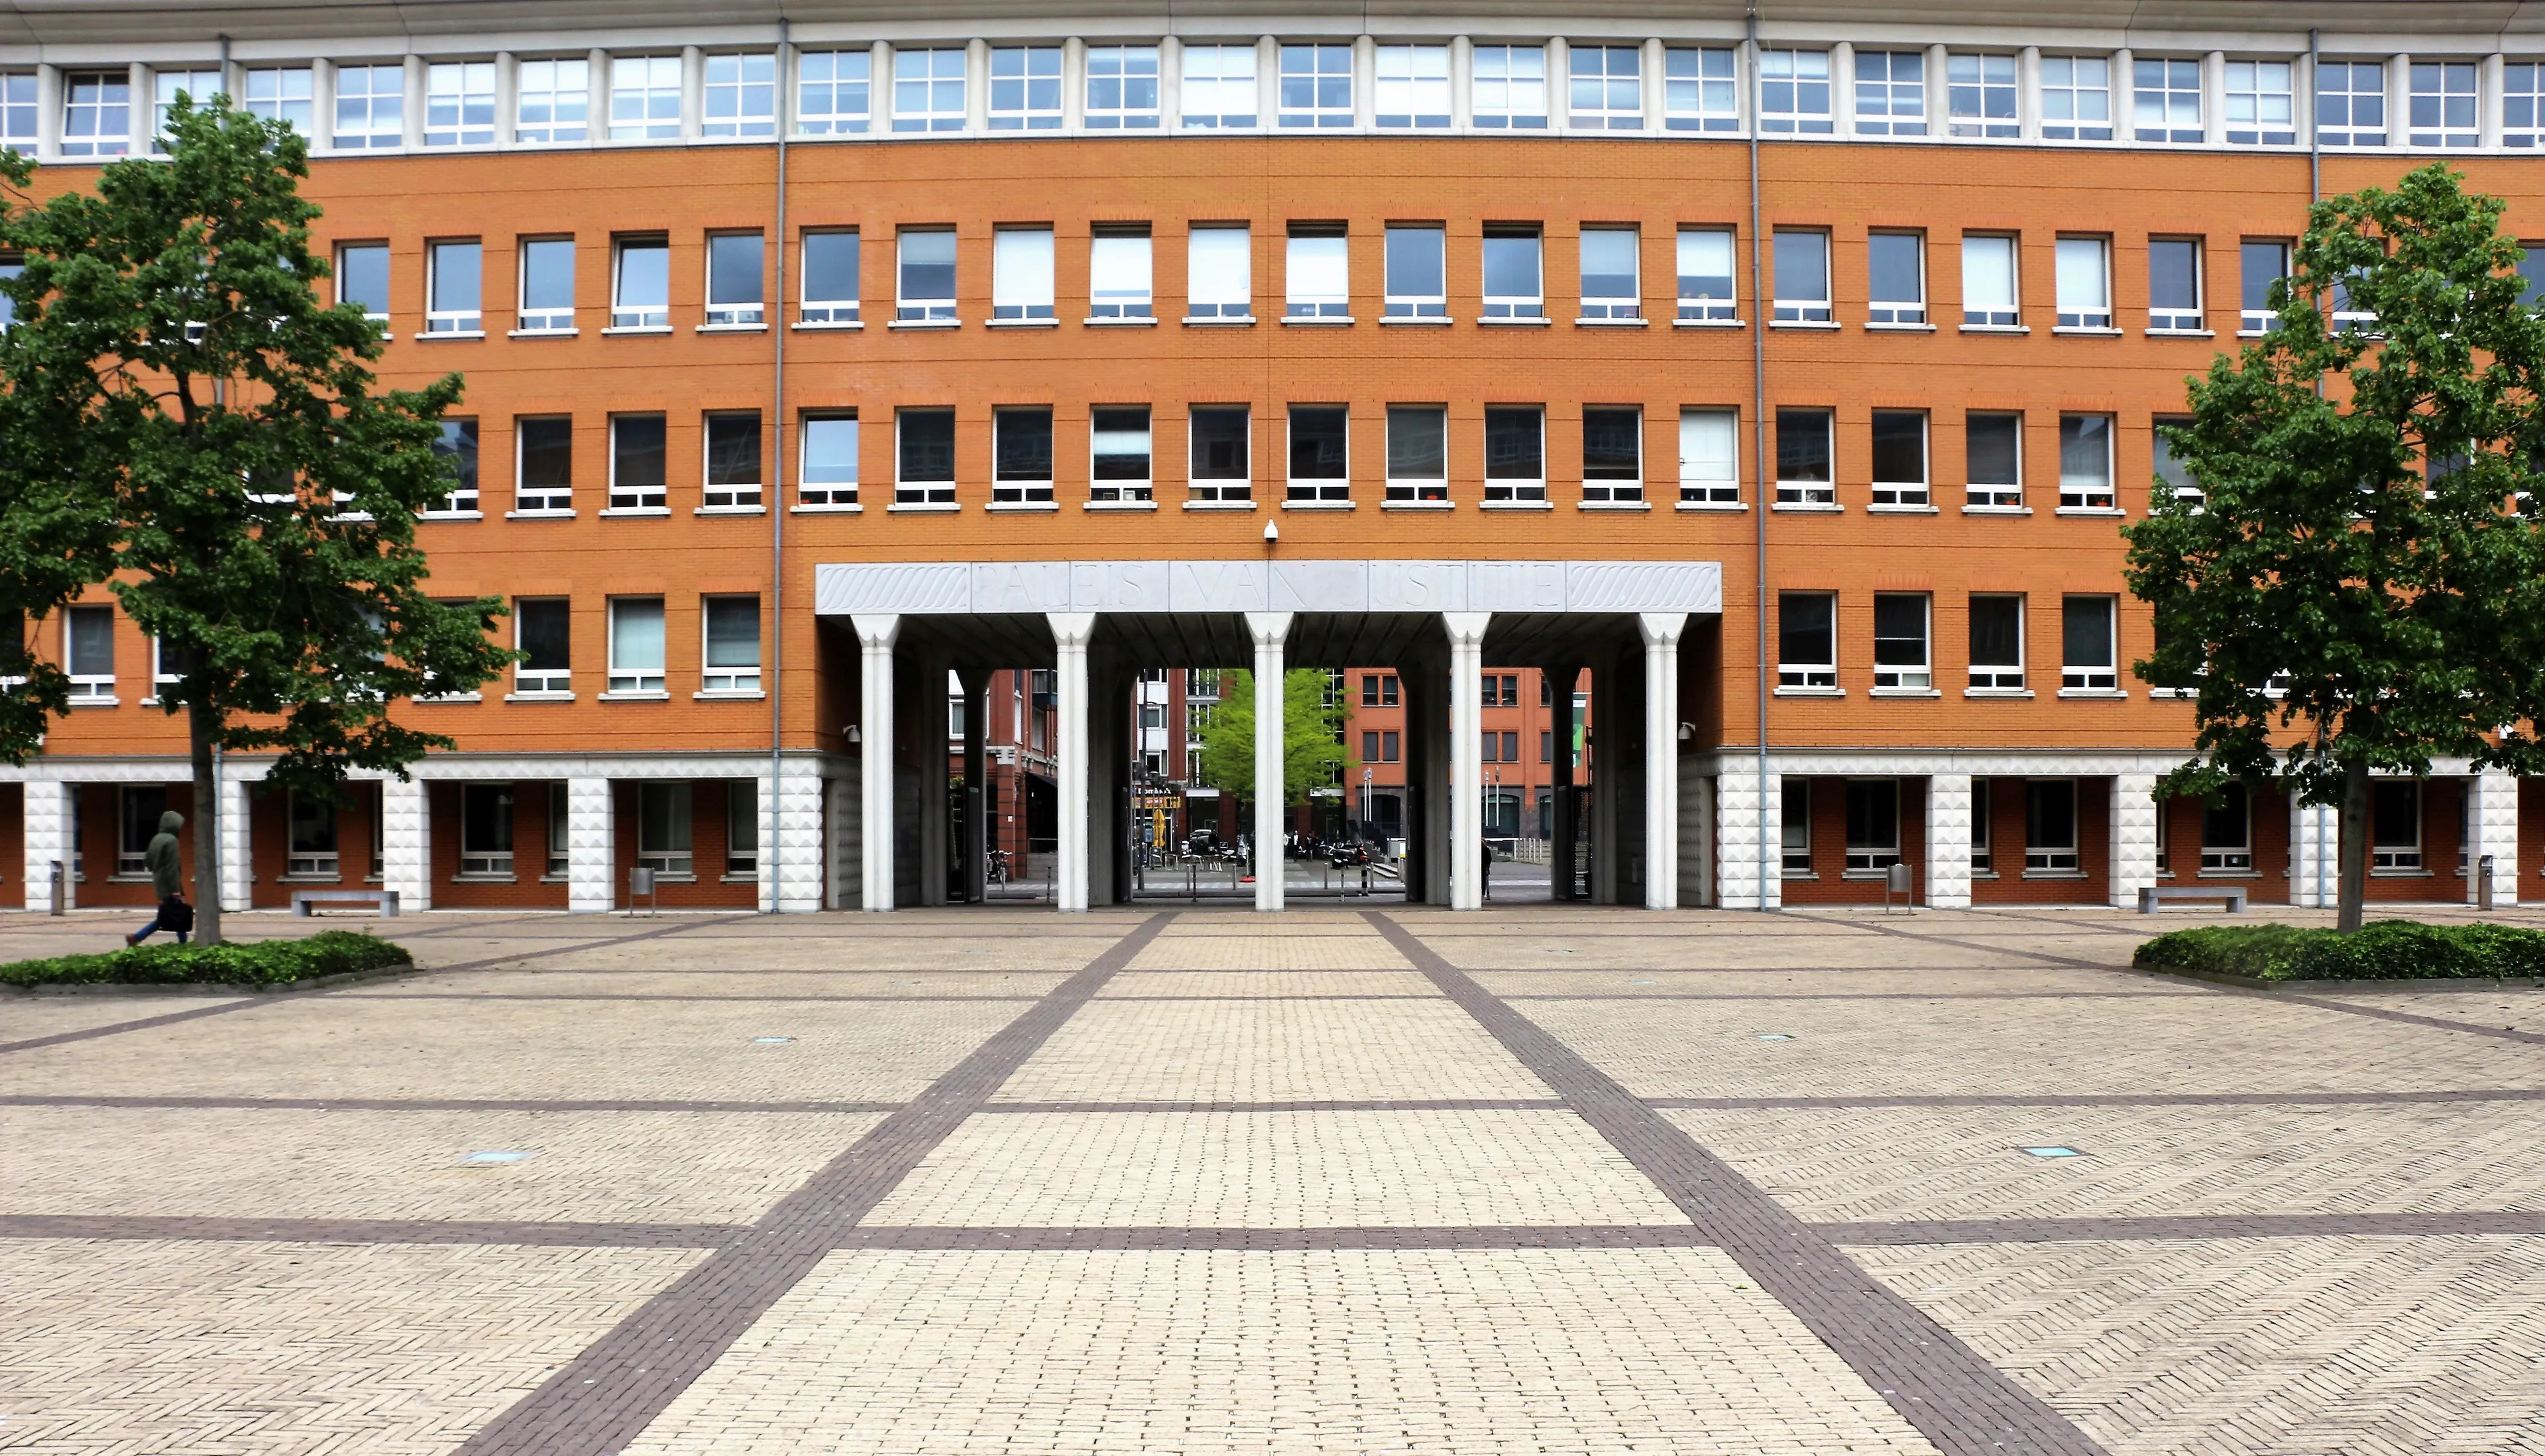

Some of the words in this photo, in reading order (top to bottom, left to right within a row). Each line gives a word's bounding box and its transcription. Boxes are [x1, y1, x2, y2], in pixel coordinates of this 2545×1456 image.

[979, 565, 1144, 607] PALEIS
[1187, 565, 1307, 607] VAN
[1339, 564, 1559, 607] JUSTITIE
